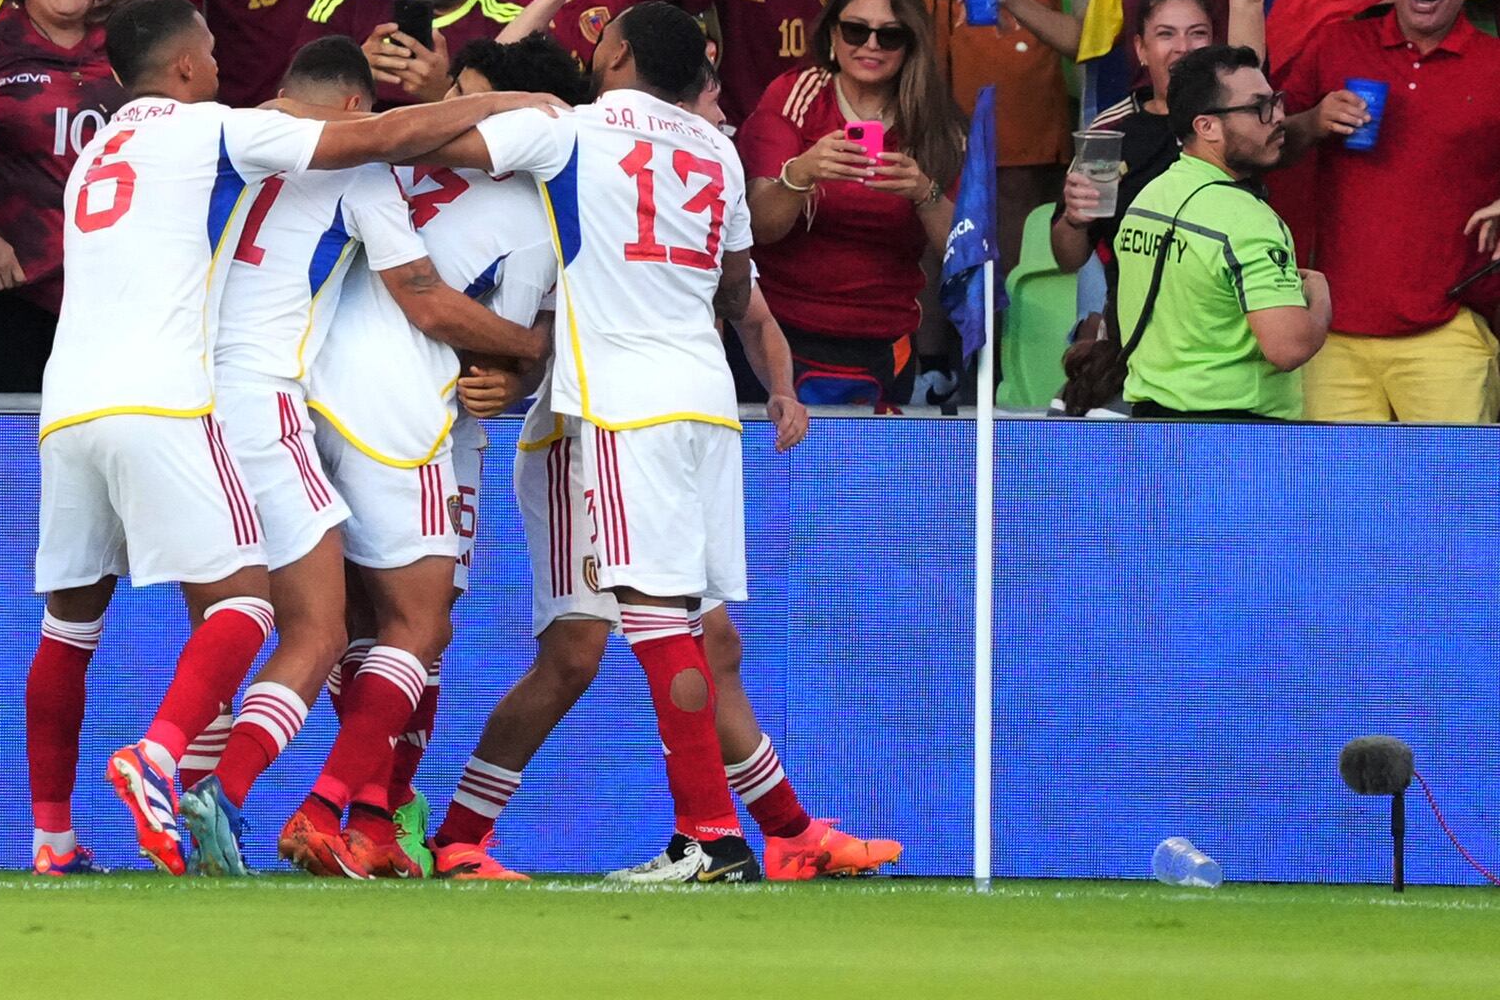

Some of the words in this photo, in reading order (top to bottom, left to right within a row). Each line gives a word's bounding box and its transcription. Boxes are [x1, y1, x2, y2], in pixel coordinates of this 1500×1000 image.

[778, 18, 806, 57] 10
[53, 107, 107, 157] 10
[73, 128, 137, 234] 6
[618, 150, 726, 281] 13
[1120, 228, 1188, 264] ECURTY
